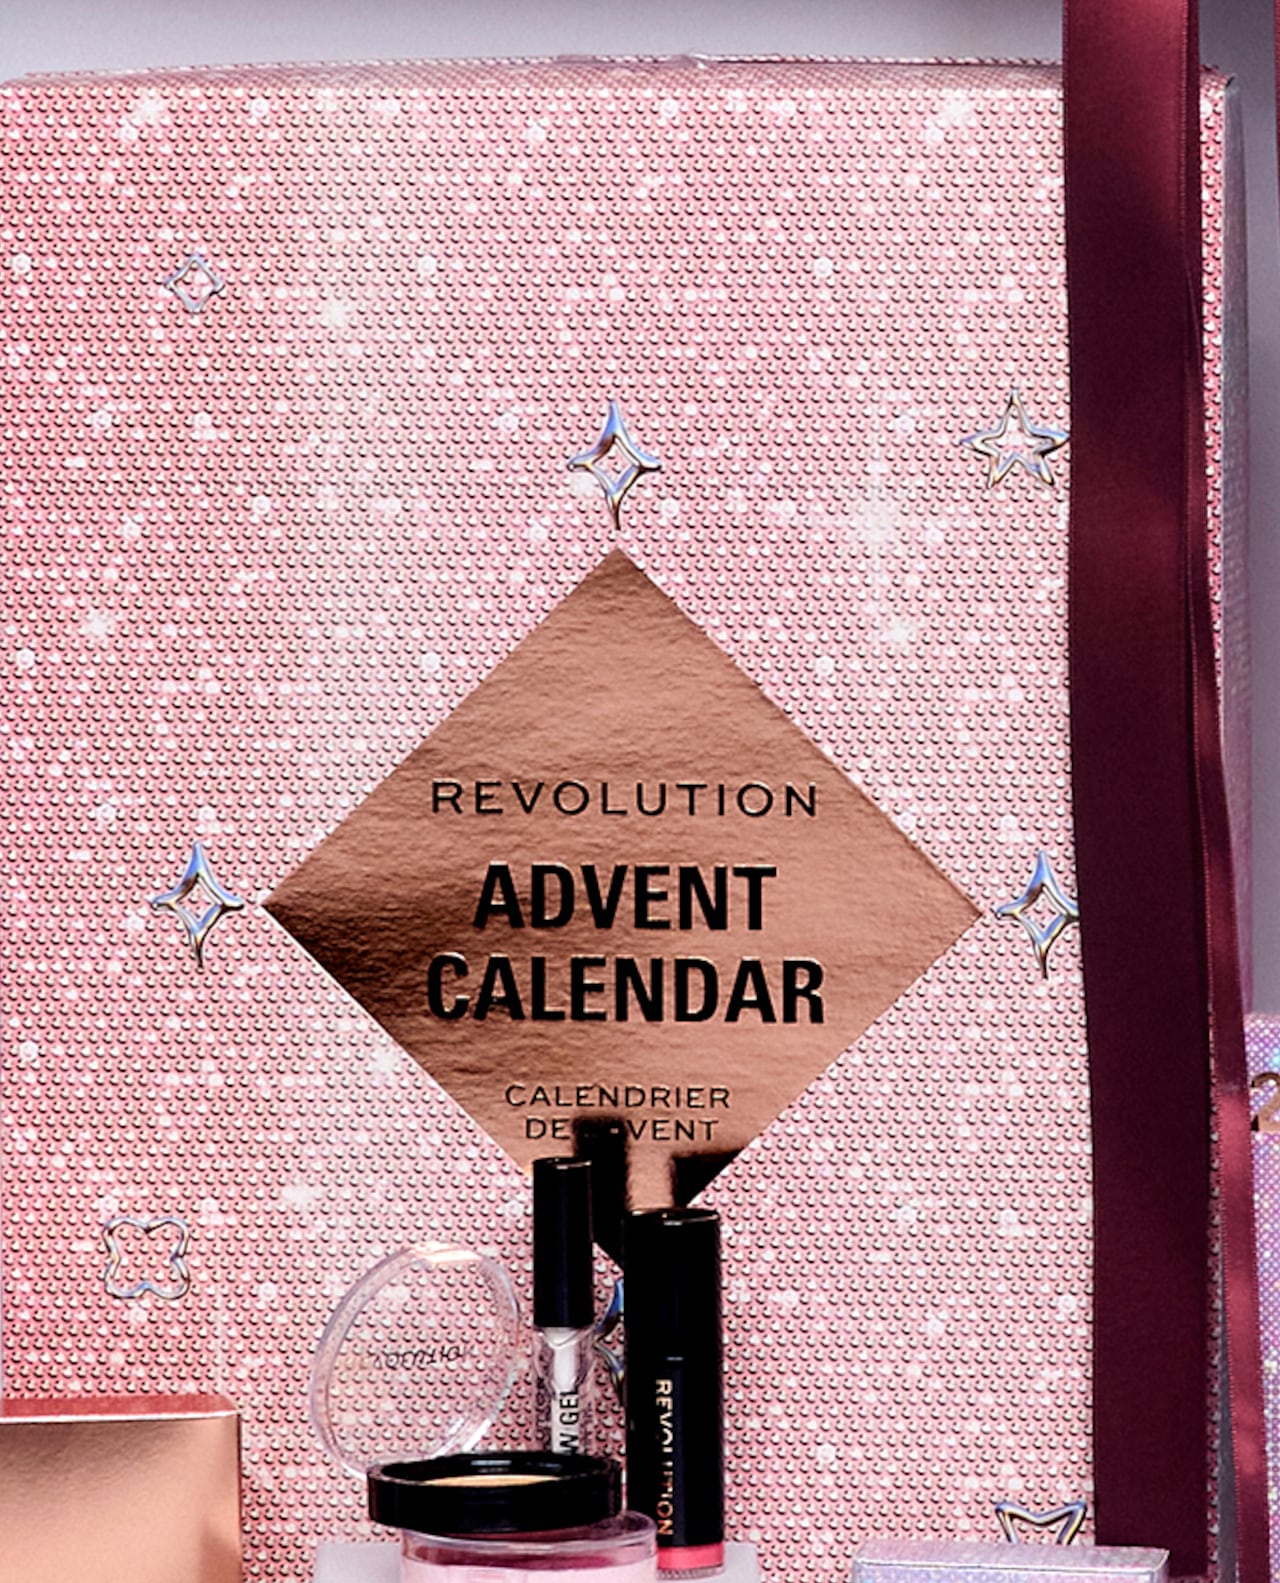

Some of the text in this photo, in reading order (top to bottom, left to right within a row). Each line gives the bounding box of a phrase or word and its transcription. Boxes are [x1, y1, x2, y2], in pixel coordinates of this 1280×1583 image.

[431, 780, 817, 817] REVOLUTION
[472, 862, 777, 931] ADVENT
[427, 953, 826, 1025] CALENDAR
[505, 1084, 731, 1109] CALENDRIER
[525, 1118, 571, 1140] DE
[559, 1385, 580, 1426] GEL
